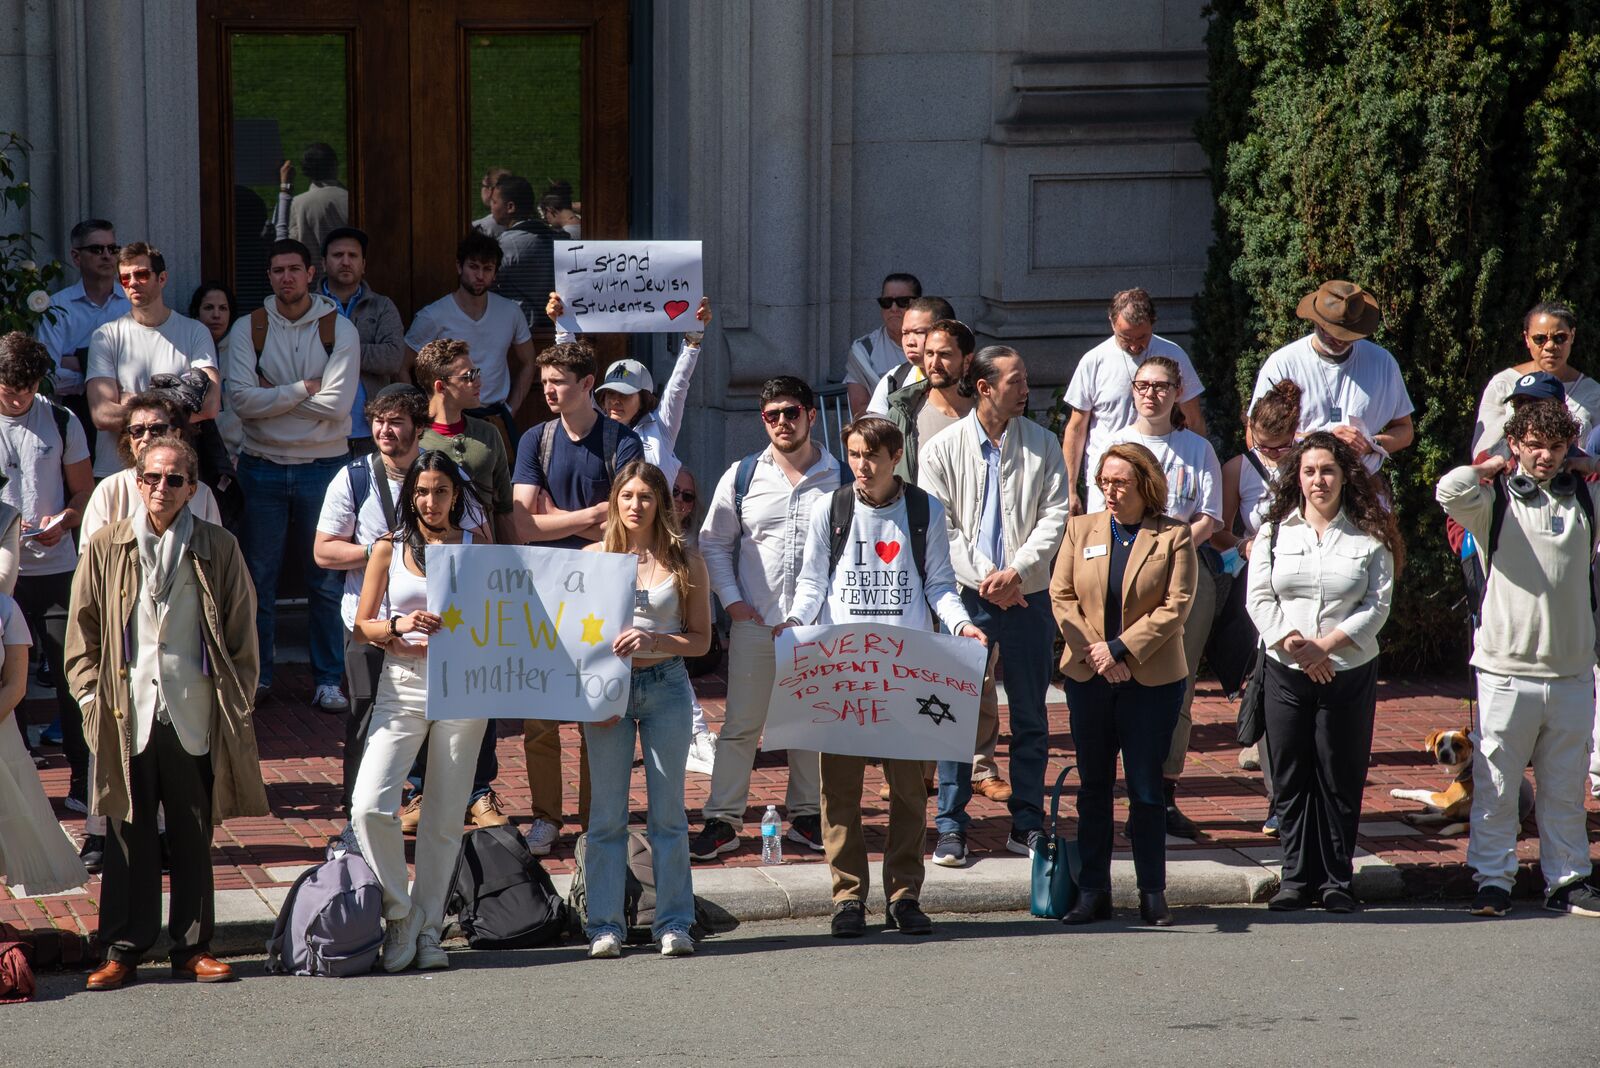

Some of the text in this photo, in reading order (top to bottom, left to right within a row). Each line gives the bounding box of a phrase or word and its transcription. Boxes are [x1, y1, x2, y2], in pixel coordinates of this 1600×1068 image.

[567, 245, 649, 275] I stand
[592, 275, 689, 293] with Jewish
[572, 297, 655, 316] Students
[855, 541, 867, 566] I
[450, 554, 585, 596] I am a
[845, 570, 909, 587] BEING
[841, 588, 913, 605] JEWISH
[470, 599, 566, 651] JEW
[793, 632, 905, 672] EVERY
[442, 656, 625, 702] I matter too
[779, 660, 979, 697] STUDENT DESERVES
[790, 679, 905, 700] TO FEEL
[811, 697, 891, 726] SAFE
